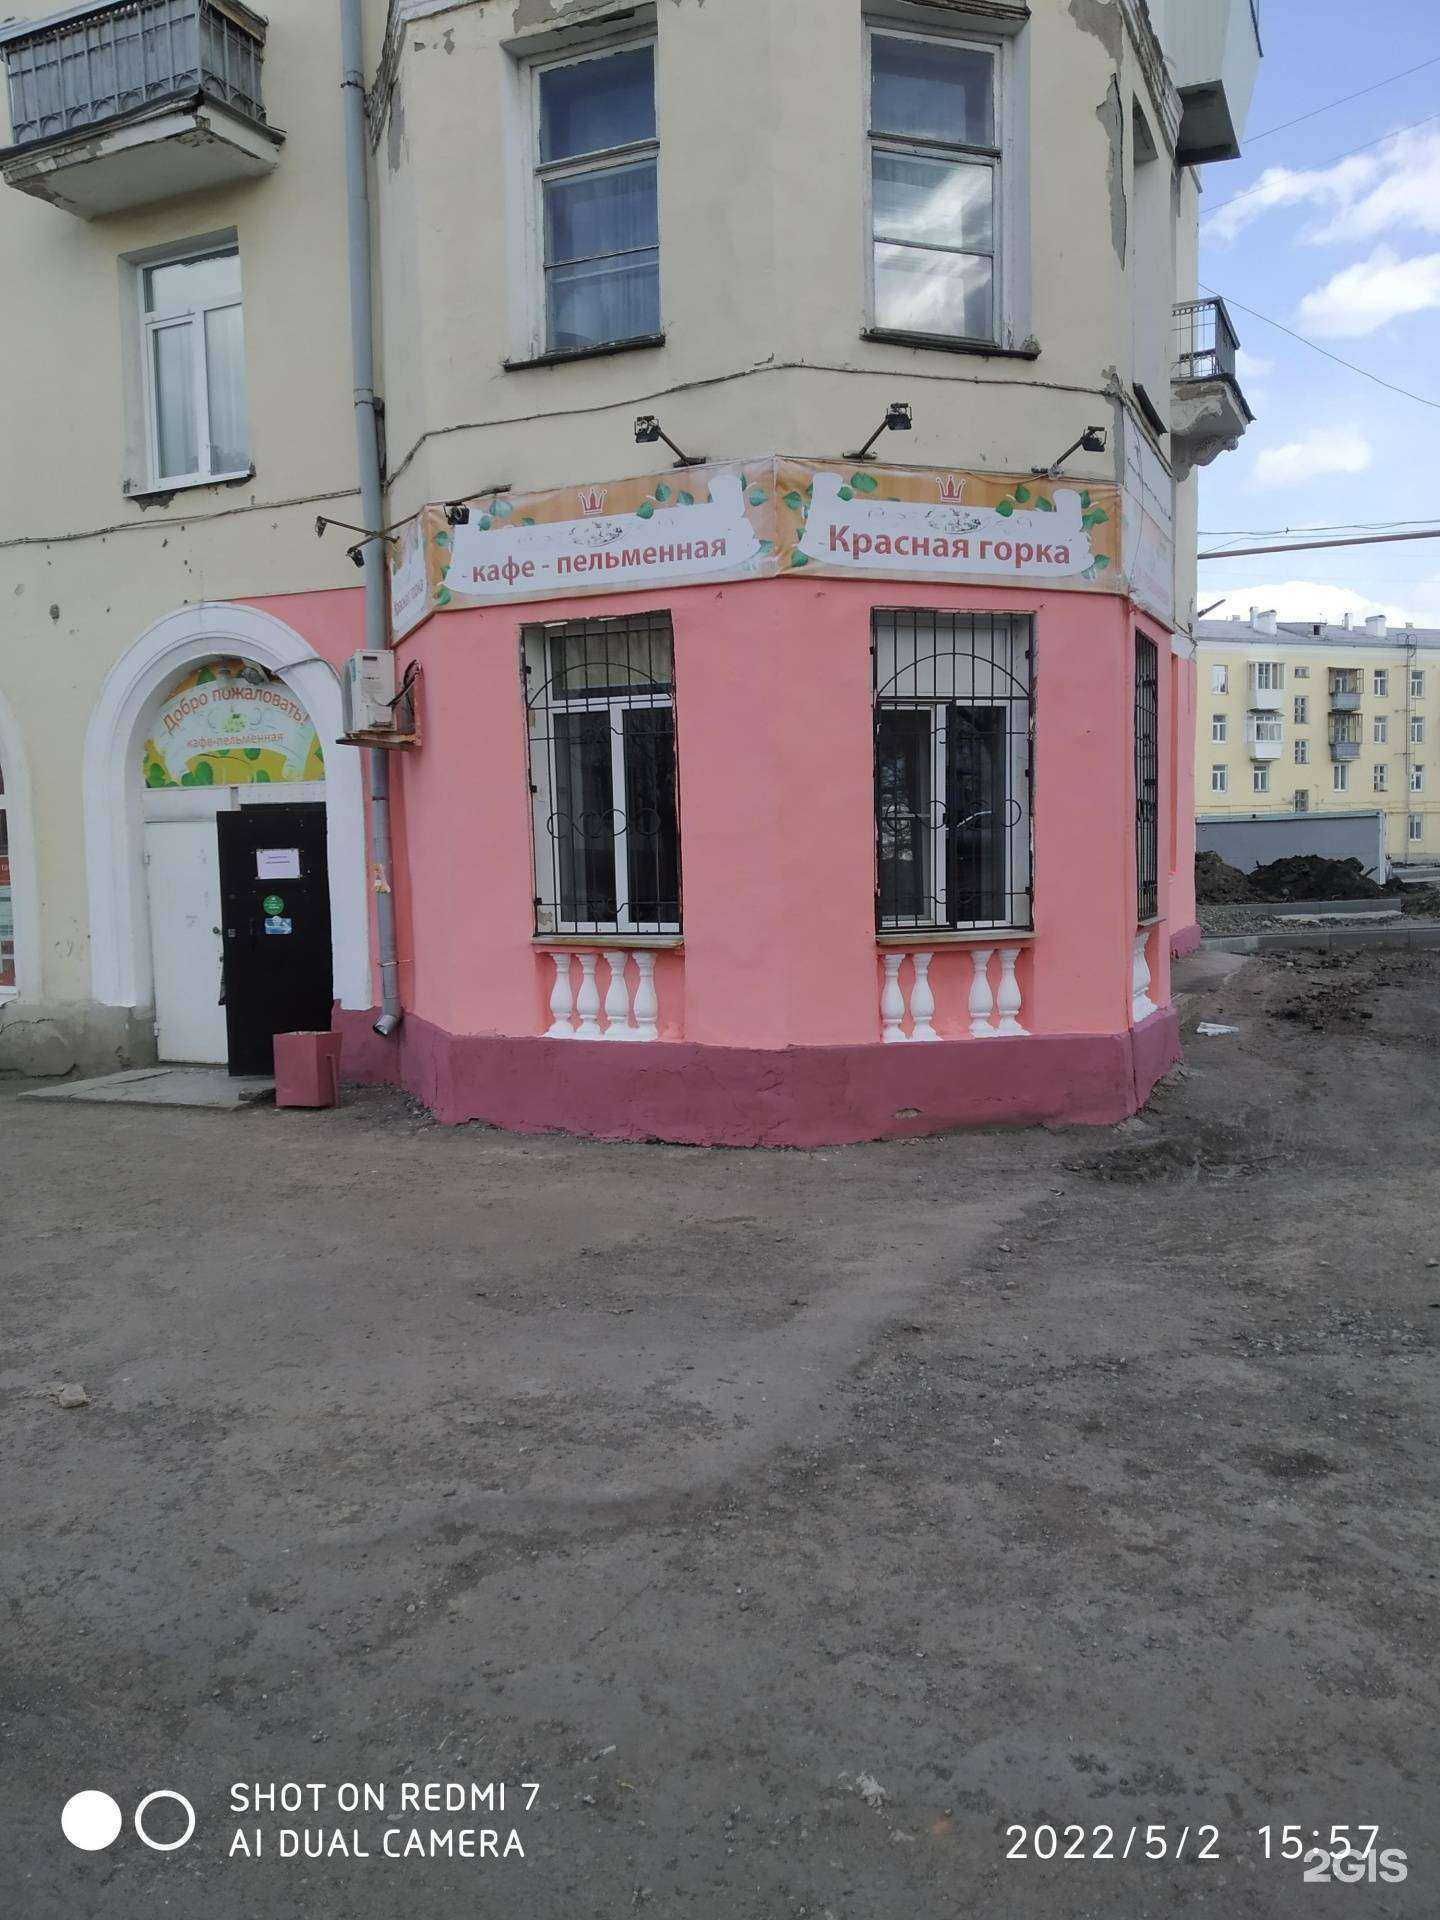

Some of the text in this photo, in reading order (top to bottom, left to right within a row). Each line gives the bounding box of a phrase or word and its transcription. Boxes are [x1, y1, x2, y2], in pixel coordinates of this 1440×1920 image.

[472, 556, 535, 585] кафе
[556, 538, 727, 575] пельменная
[828, 525, 1070, 568] Красная горка
[162, 686, 311, 733] Добро пожаловать!
